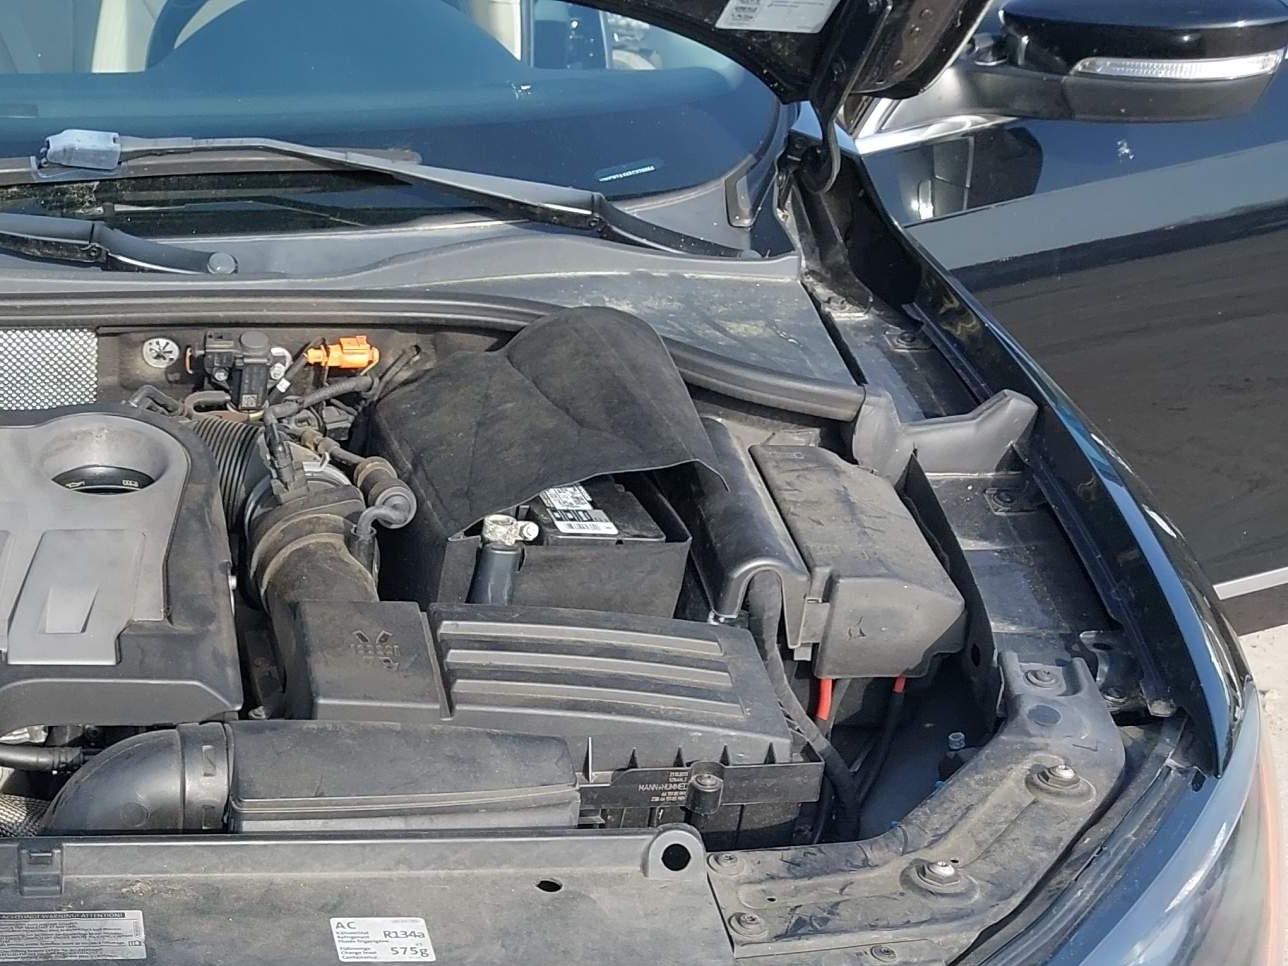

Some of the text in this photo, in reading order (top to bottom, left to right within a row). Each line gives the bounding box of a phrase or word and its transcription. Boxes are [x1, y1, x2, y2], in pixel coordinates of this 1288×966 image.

[335, 921, 357, 930] AC
[383, 930, 426, 939] R134a
[390, 946, 430, 958] 575g
